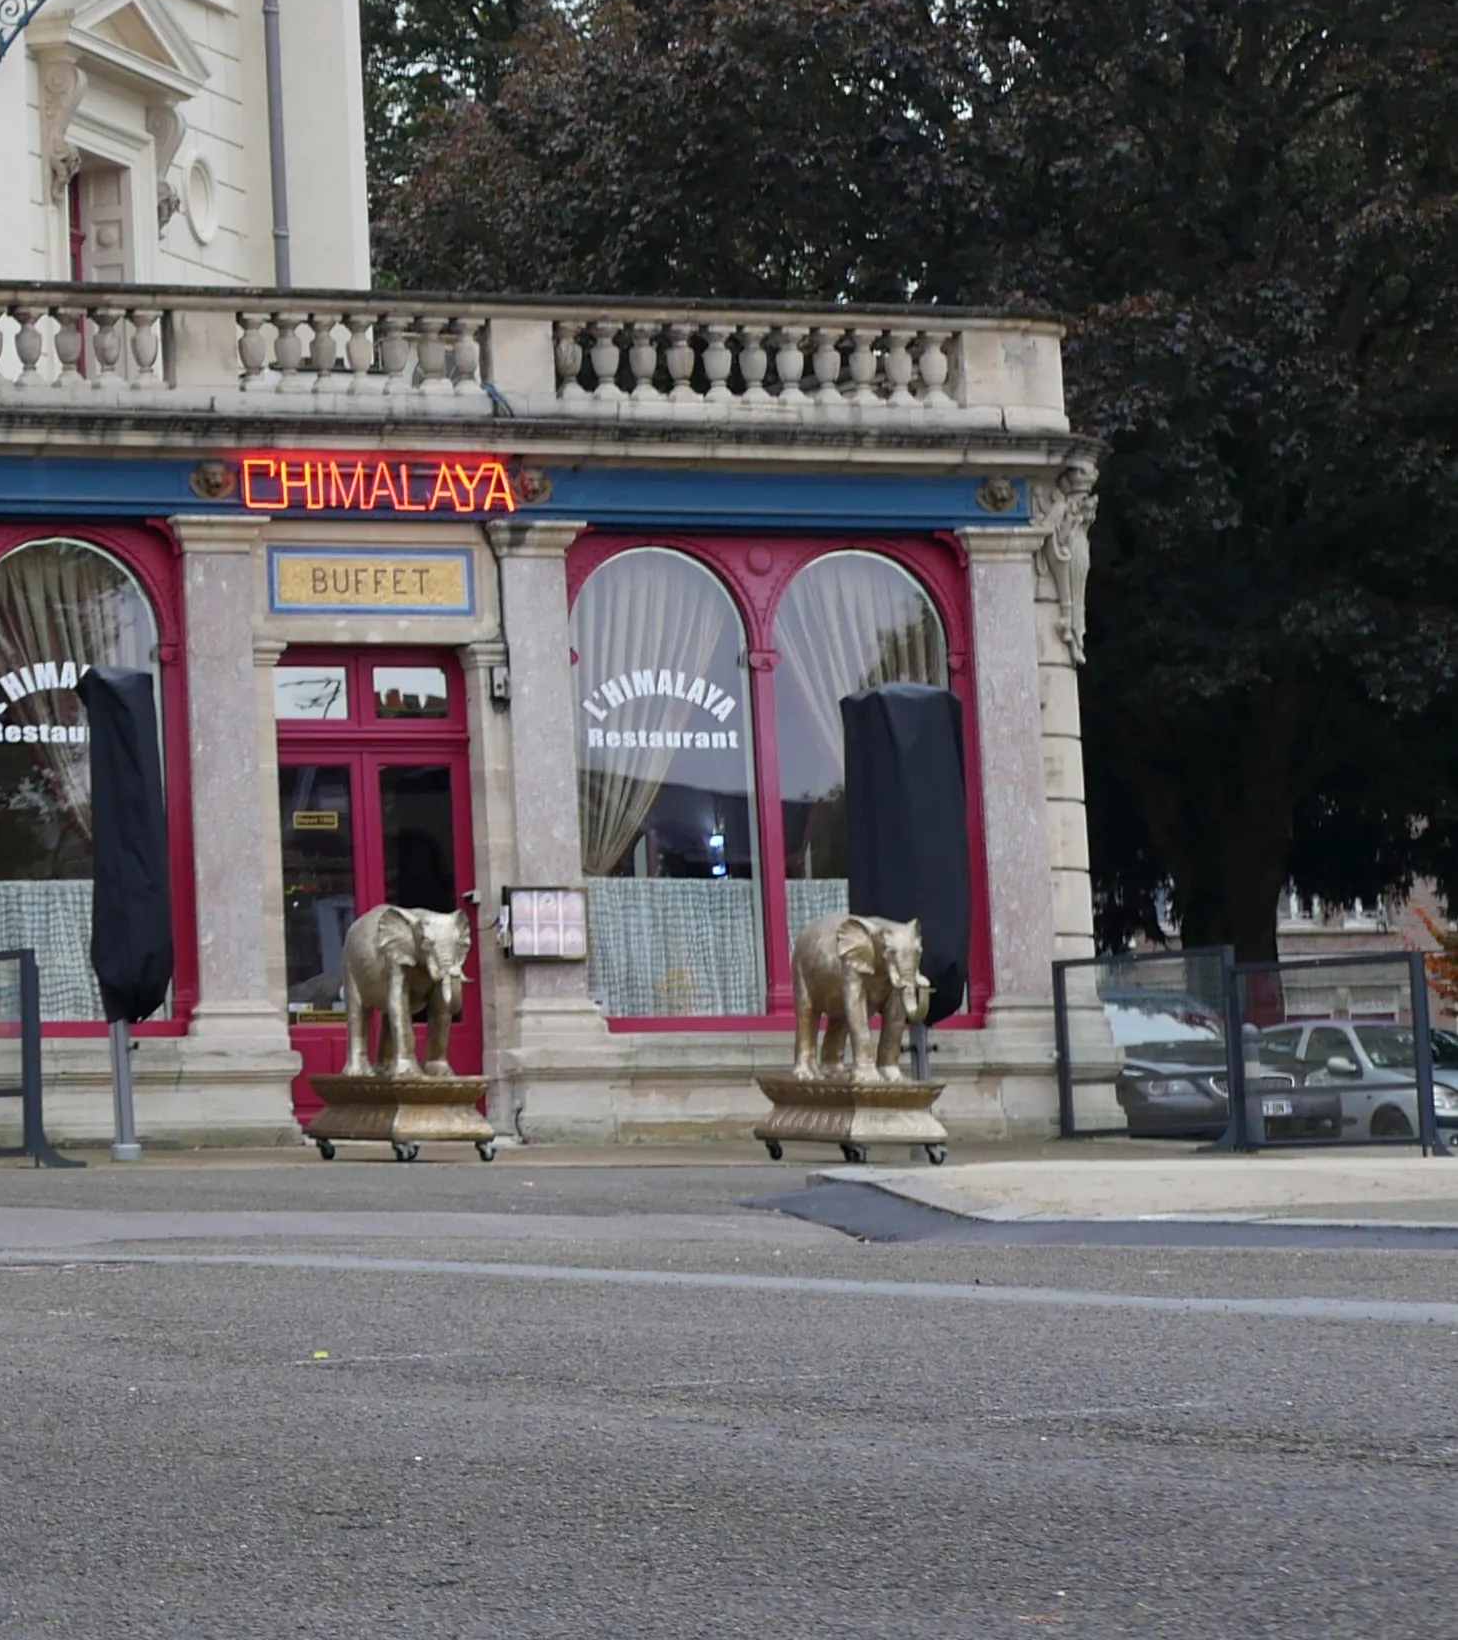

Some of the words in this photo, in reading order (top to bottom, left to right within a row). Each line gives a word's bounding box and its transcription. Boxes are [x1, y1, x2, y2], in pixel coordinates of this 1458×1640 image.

[311, 566, 431, 594] BUFFET
[582, 668, 737, 724] L'HIMALAYA
[587, 727, 739, 749] Restaurant
